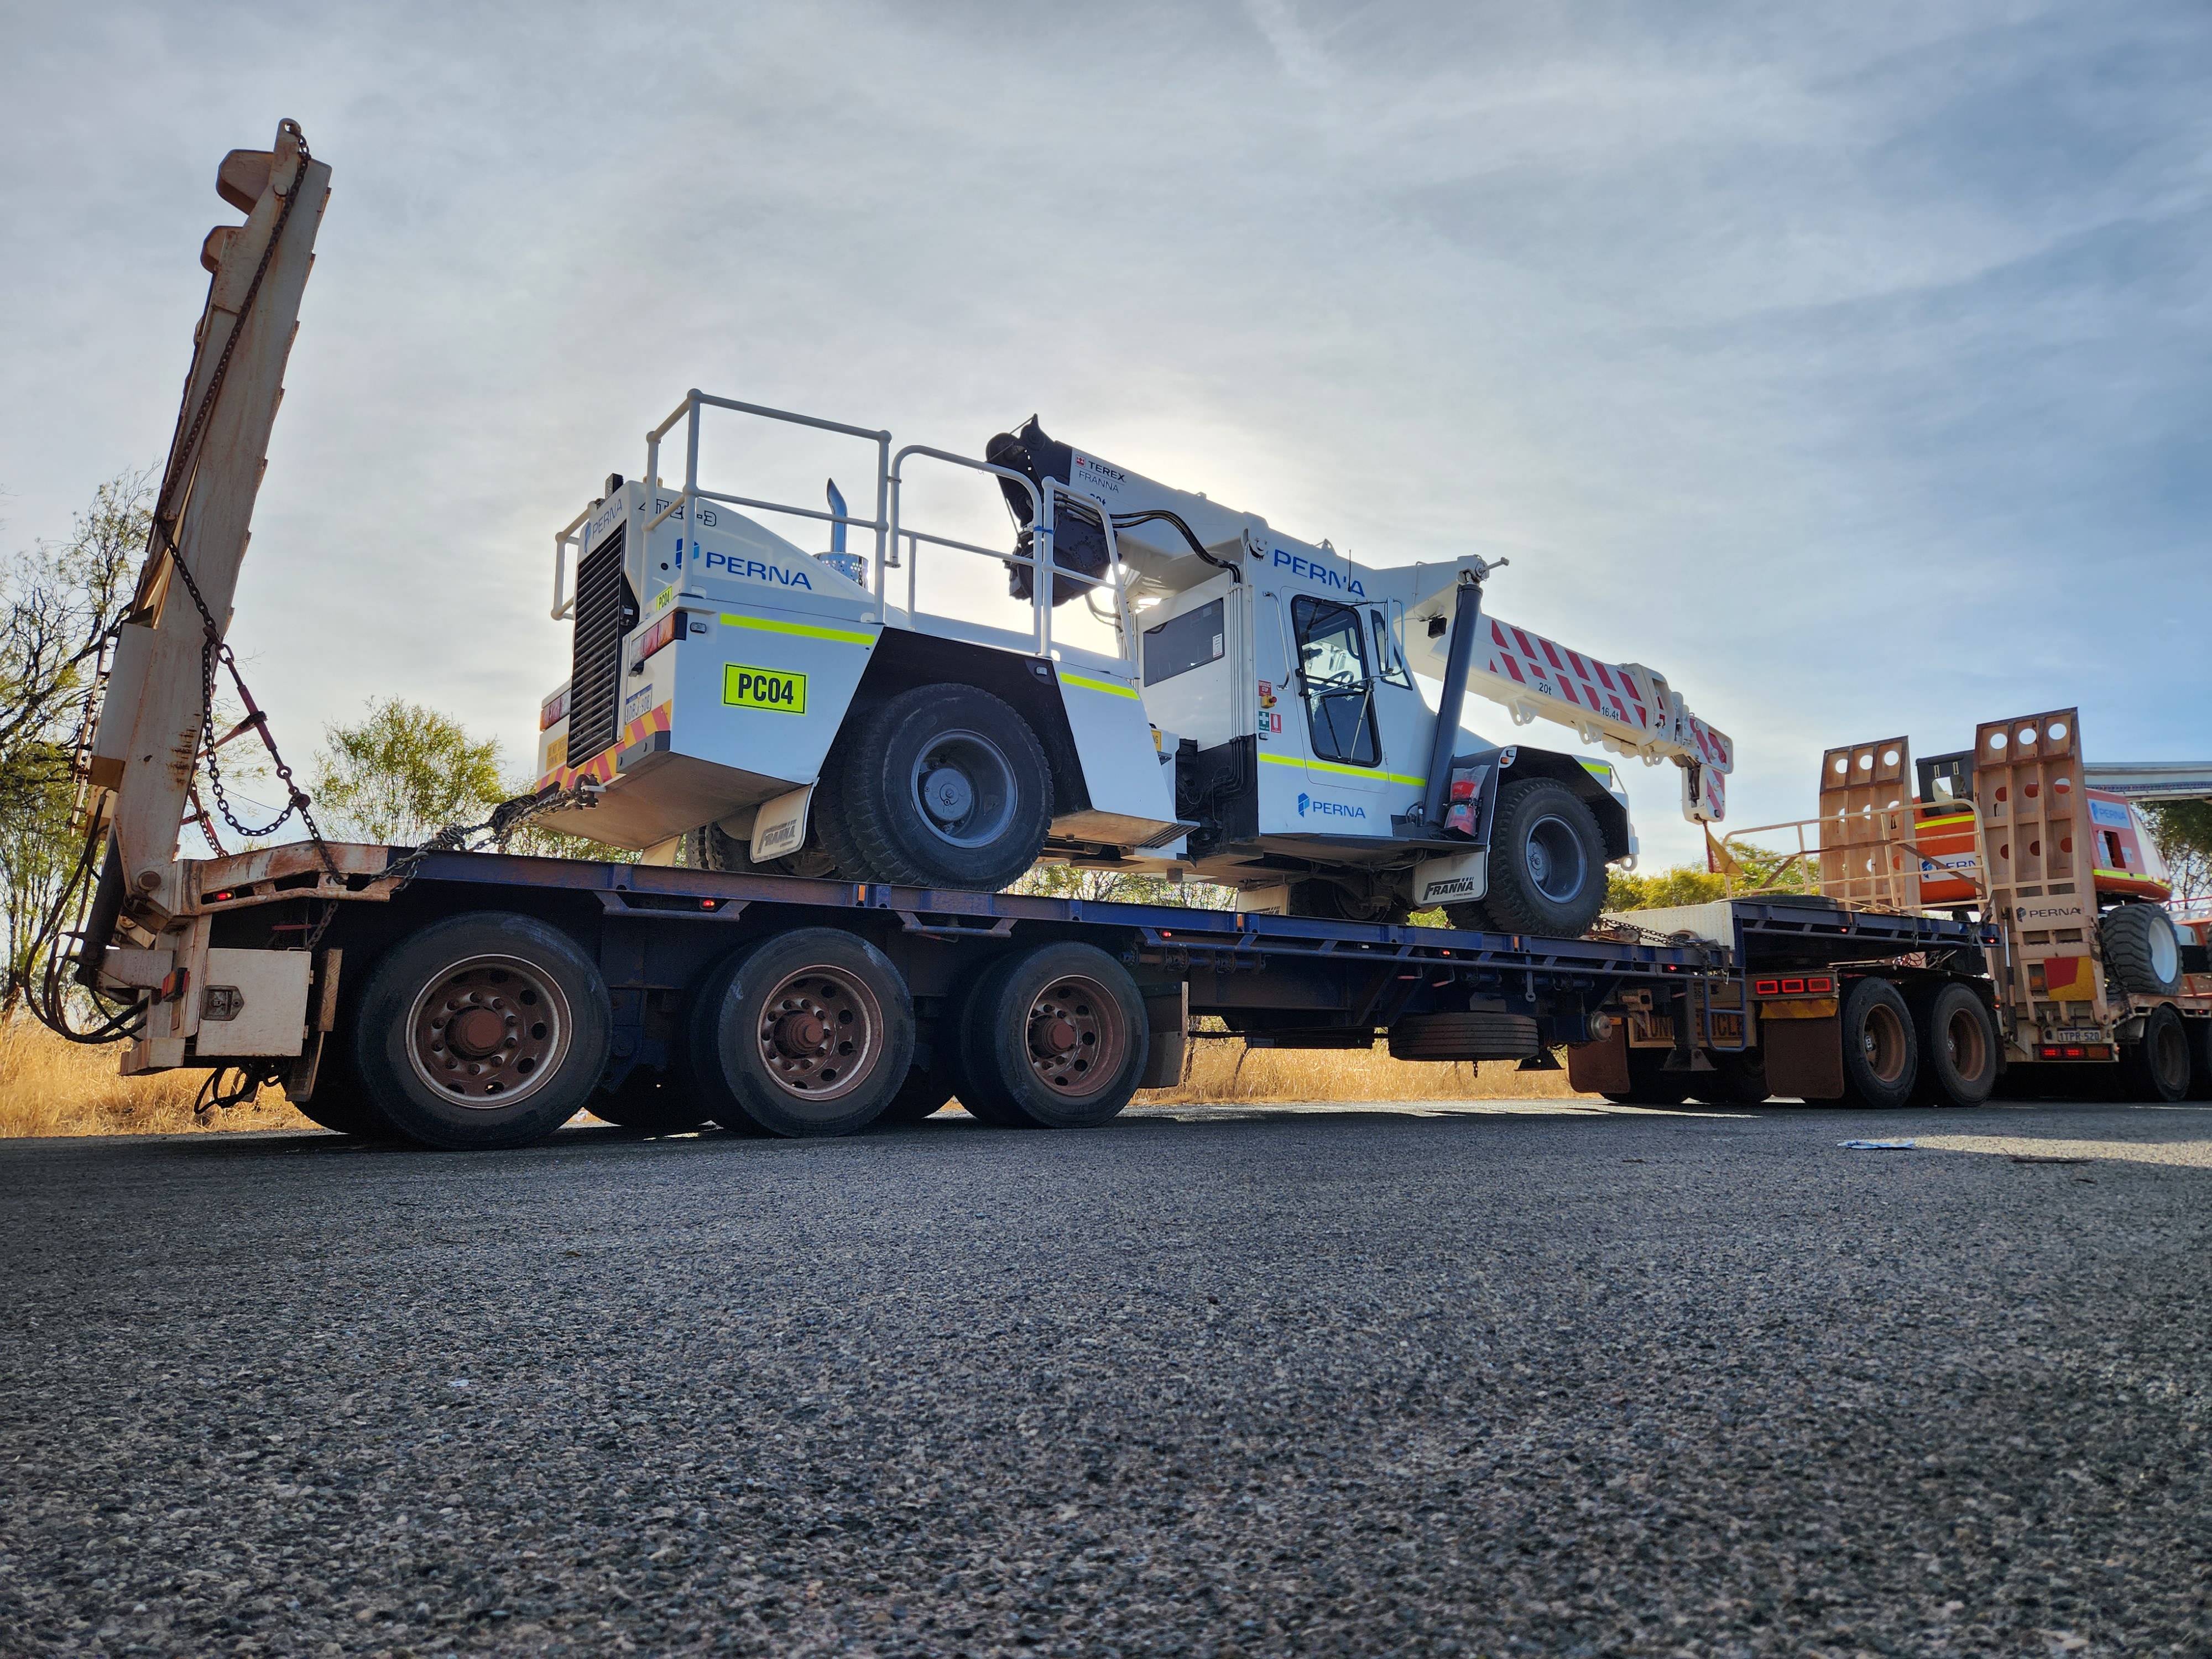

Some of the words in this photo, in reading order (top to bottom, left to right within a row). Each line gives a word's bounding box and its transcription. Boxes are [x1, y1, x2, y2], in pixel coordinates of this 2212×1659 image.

[1079, 470, 1119, 493] FRANNA
[1088, 460, 1126, 483] TEREX
[592, 498, 623, 539] PERNA
[706, 552, 812, 590] PERNA
[1274, 549, 1365, 597] PERNA
[659, 590, 670, 610] PC04
[738, 673, 794, 705] PC04
[1539, 682, 1552, 695] 20t
[1601, 706, 1619, 721] 16.4t
[1313, 801, 1366, 818] PERNA
[2099, 808, 2127, 820] PERNA
[1423, 877, 1475, 901] FRANNA
[2030, 907, 2081, 918] PERNA
